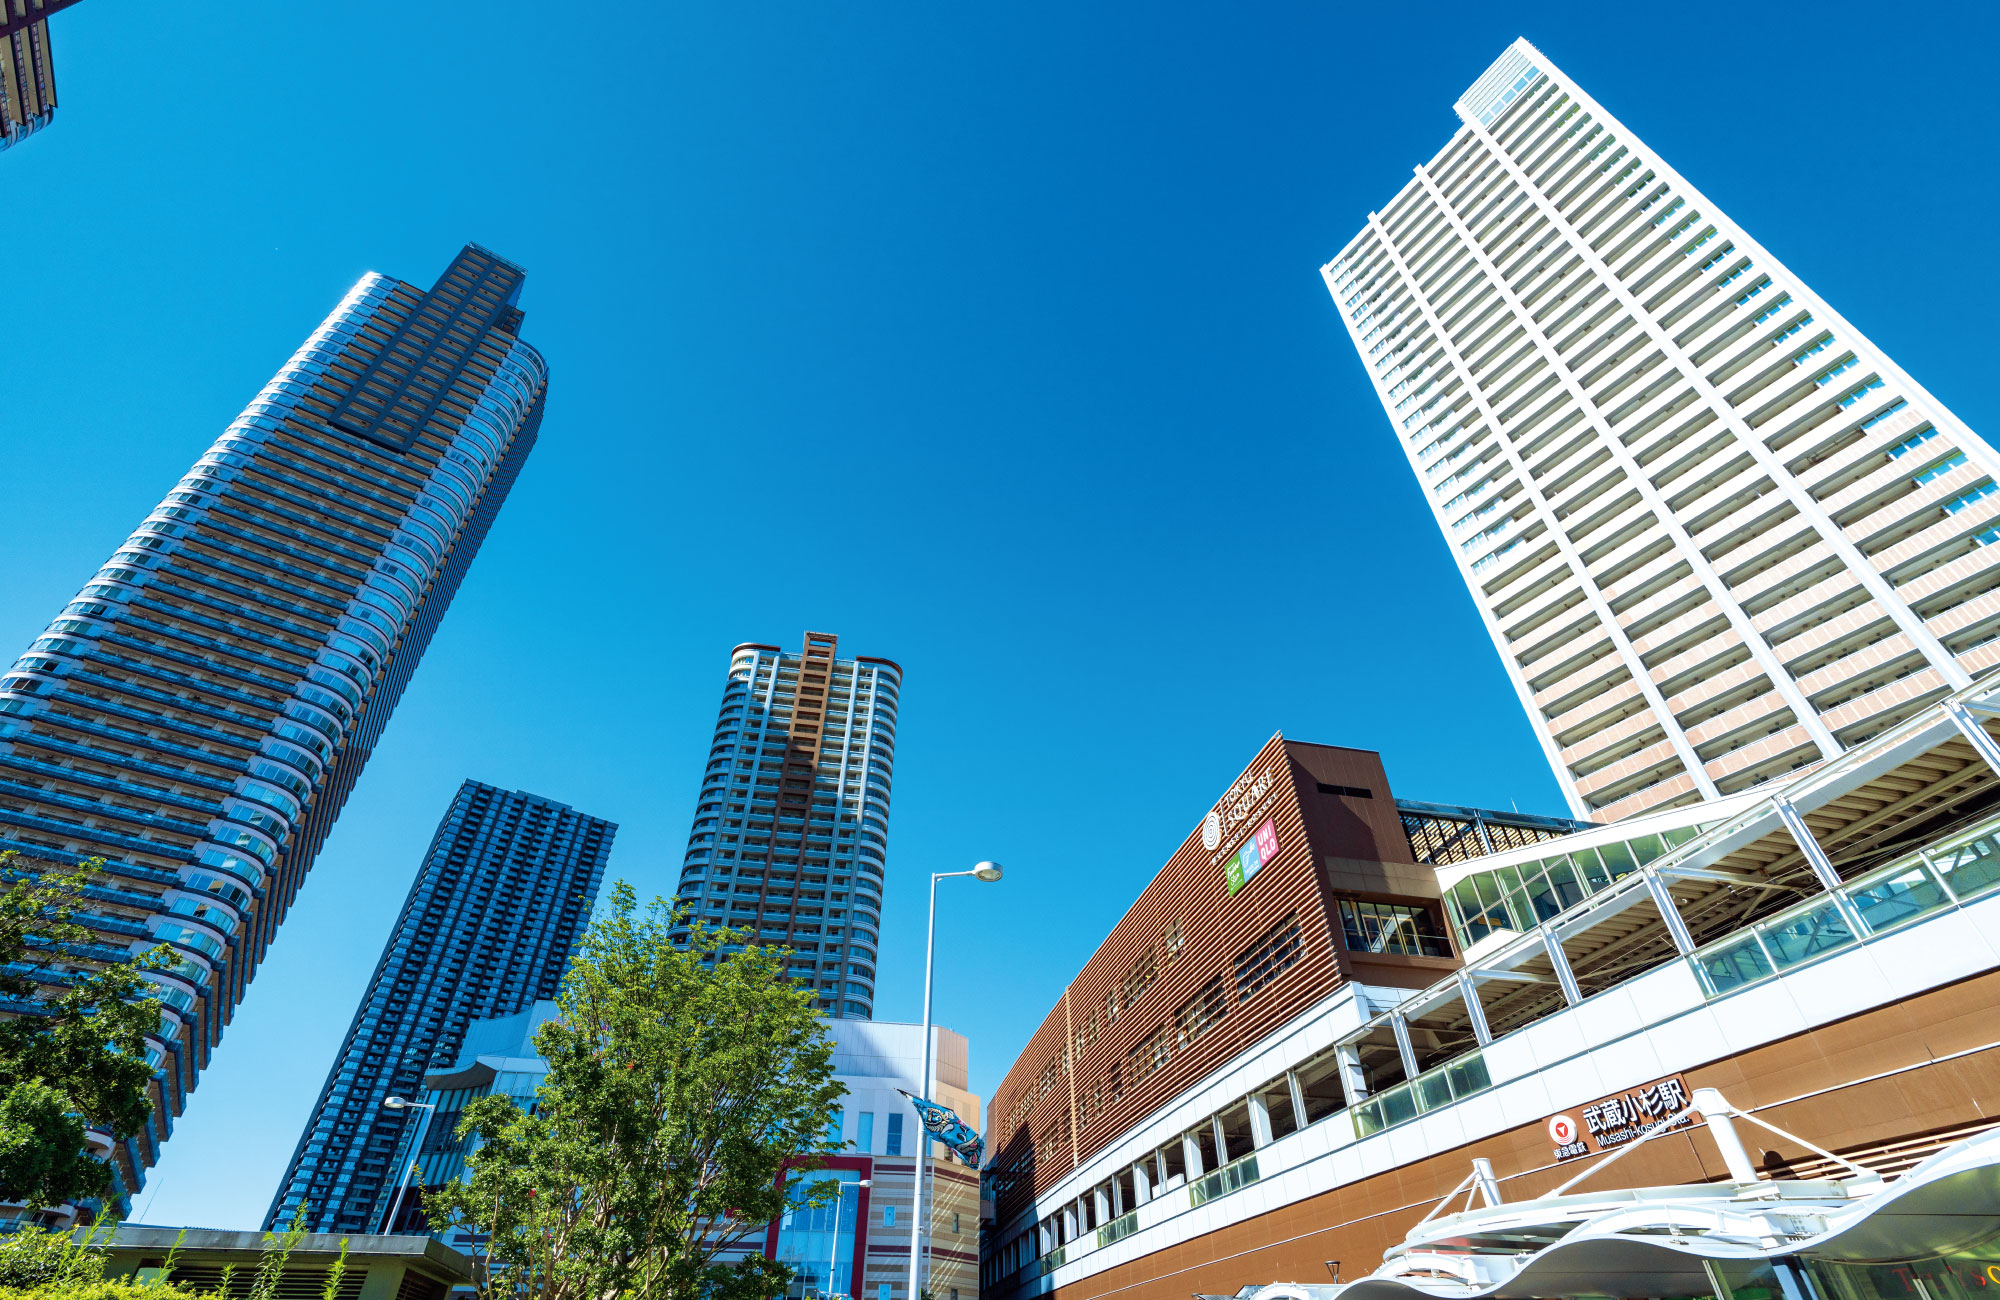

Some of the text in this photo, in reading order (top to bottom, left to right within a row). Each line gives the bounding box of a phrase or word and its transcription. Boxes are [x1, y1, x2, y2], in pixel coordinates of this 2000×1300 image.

[1225, 769, 1252, 807] TOKYU
[1228, 767, 1274, 831] SQUARE
[1257, 824, 1272, 846] UNI
[1260, 838, 1276, 861] QLO
[1582, 1078, 1688, 1134] 武蔵小杉駅
[1553, 1141, 1587, 1160] 東急電鉄
